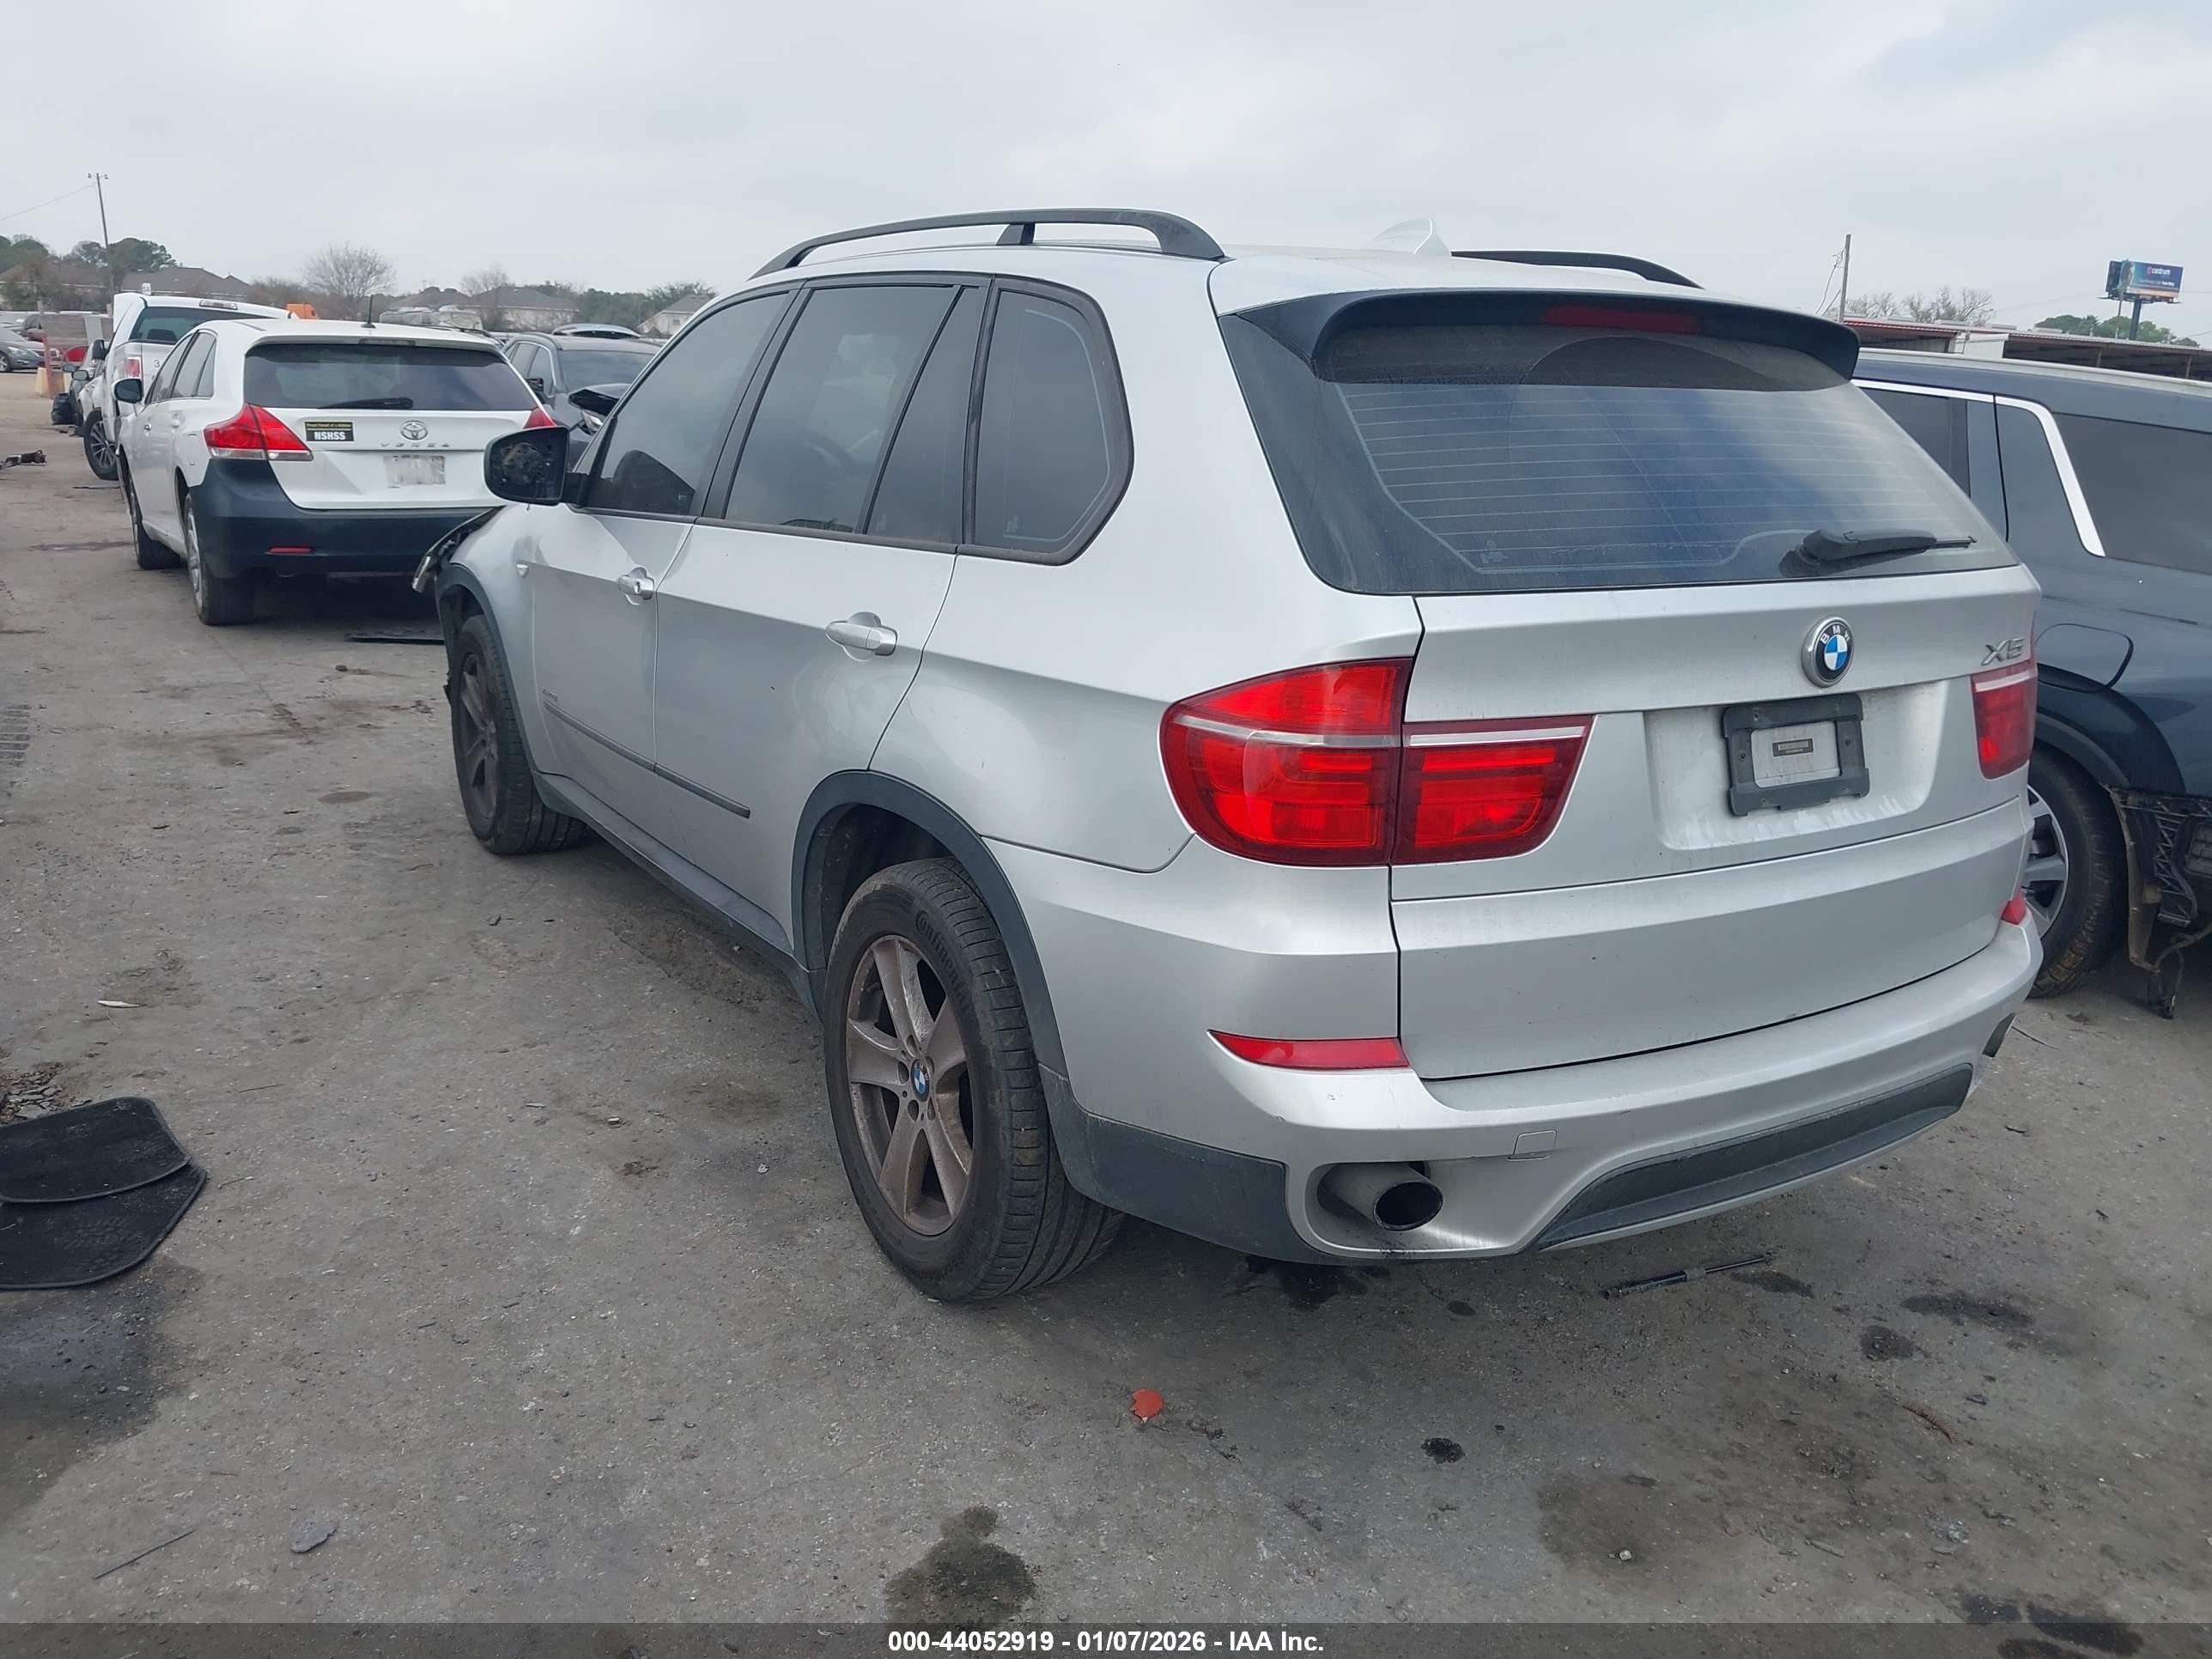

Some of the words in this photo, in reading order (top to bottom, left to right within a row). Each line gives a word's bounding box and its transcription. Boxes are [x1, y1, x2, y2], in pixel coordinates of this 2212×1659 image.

[314, 431, 346, 441] NSHSS
[1820, 624, 1850, 645] BMW
[1980, 637, 2026, 666] X5
